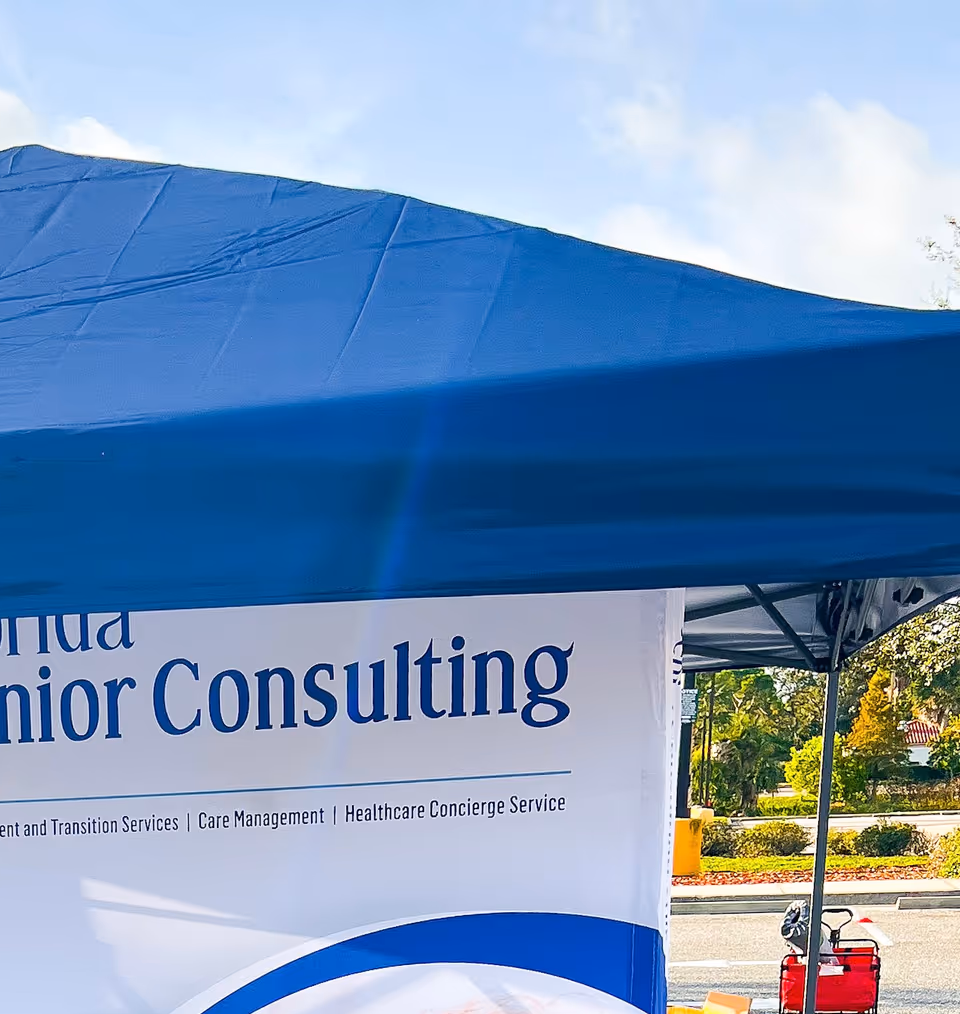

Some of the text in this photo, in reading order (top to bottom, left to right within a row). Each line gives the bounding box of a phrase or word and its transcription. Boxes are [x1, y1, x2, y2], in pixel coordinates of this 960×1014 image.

[153, 635, 575, 736] Consulting
[23, 818, 47, 837] and
[50, 816, 118, 836] Transition
[121, 813, 179, 833] Services
[198, 811, 230, 830] Care
[234, 807, 325, 830] Management
[345, 803, 425, 823] Healthcare
[429, 798, 505, 819] Concierge
[509, 793, 566, 814] Service
